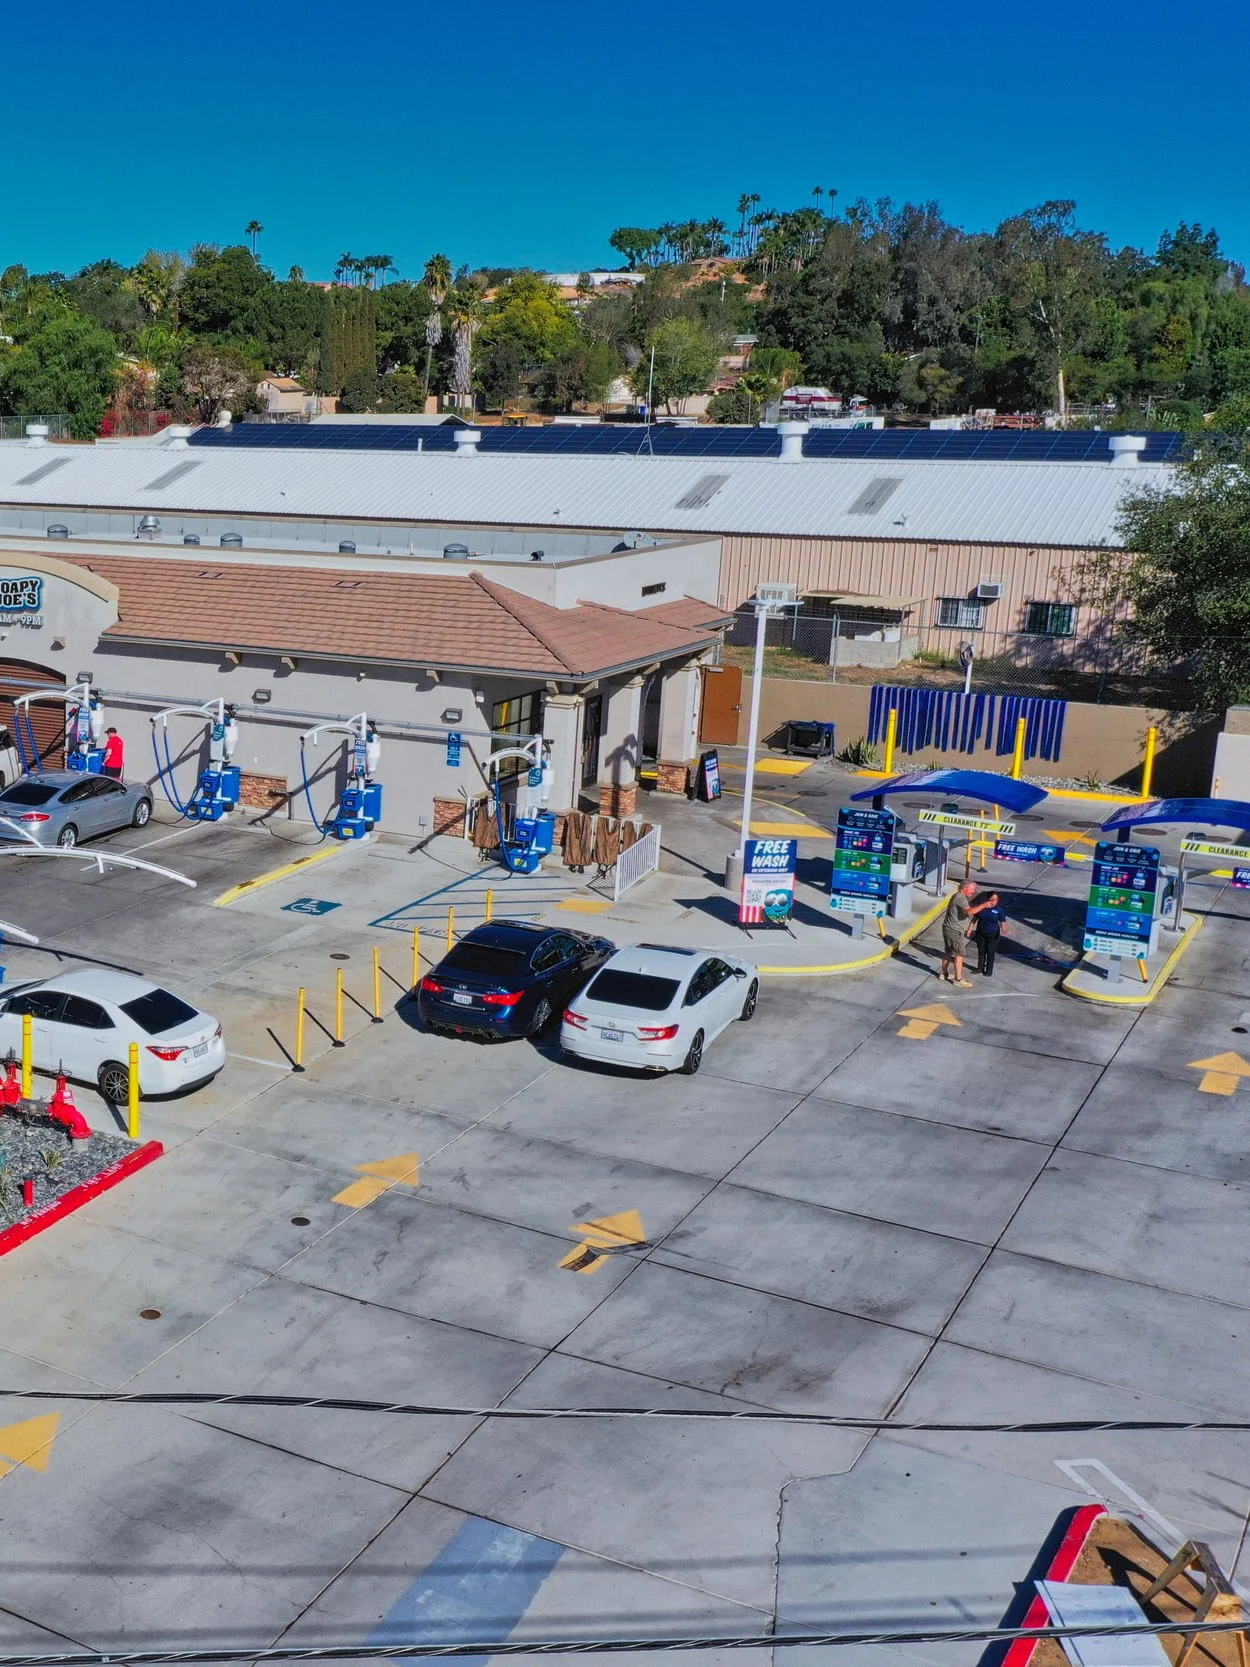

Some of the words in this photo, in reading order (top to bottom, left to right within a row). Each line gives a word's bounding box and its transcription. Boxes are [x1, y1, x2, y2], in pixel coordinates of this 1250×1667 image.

[21, 615, 41, 625] 9PM
[943, 816, 977, 828] CLEARANCE
[754, 840, 791, 855] FREE
[997, 843, 1016, 851] FREE
[1016, 846, 1037, 854] WASH
[1208, 846, 1248, 858] CLEARANCE
[751, 854, 789, 868] WASH
[31, 1200, 62, 1218] PARKING
[81, 1176, 102, 1192] FIRE
[101, 1163, 124, 1179] LANE
